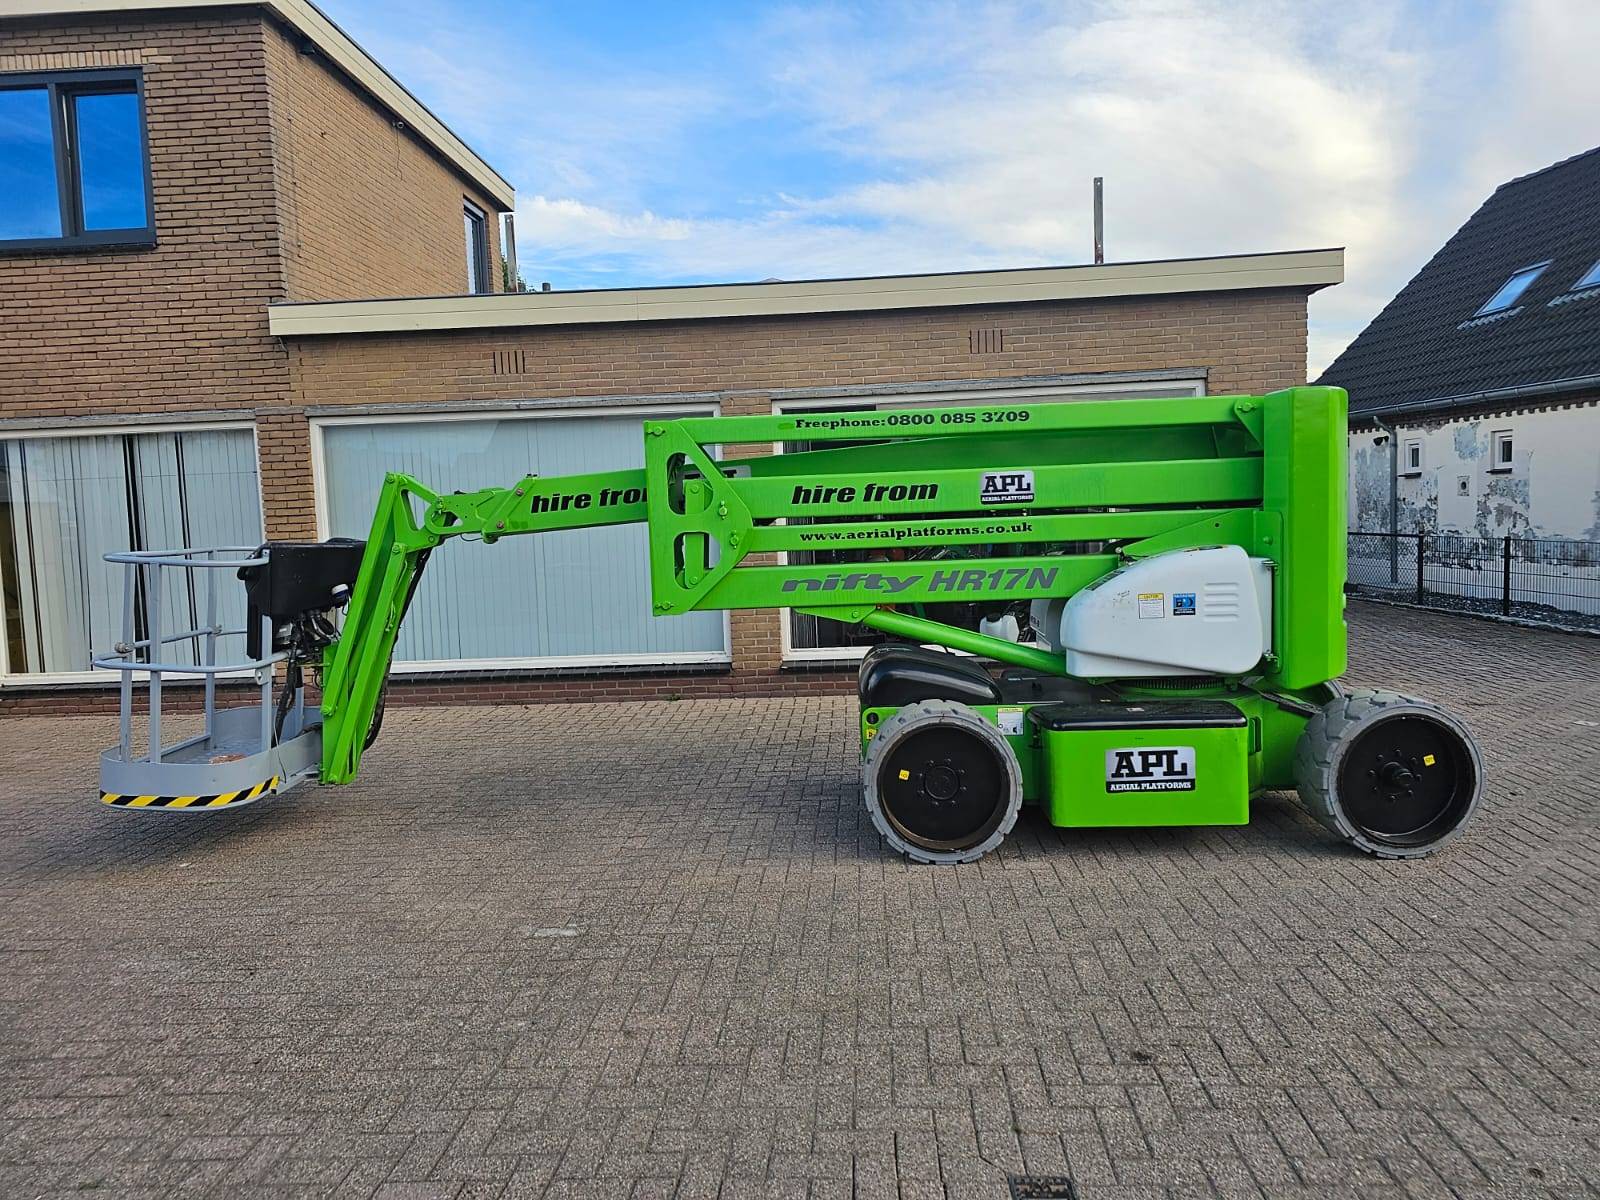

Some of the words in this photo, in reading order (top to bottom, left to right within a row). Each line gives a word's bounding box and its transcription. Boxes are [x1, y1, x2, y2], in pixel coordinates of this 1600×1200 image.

[887, 413, 935, 426] 0800
[940, 412, 976, 424] 085
[981, 410, 1030, 423] 3709
[791, 485, 856, 505] hire
[862, 483, 939, 502] from
[982, 474, 1031, 493] APL
[531, 494, 592, 514] hire
[599, 486, 648, 507] fro
[800, 522, 1033, 542] www.aerialplatforms.co.uk
[781, 573, 924, 593] nifty
[927, 567, 1059, 592] HR17N
[1111, 750, 1188, 778] APL
[1110, 783, 1140, 791] AERIAL
[1141, 782, 1191, 790] PLATFORMS
